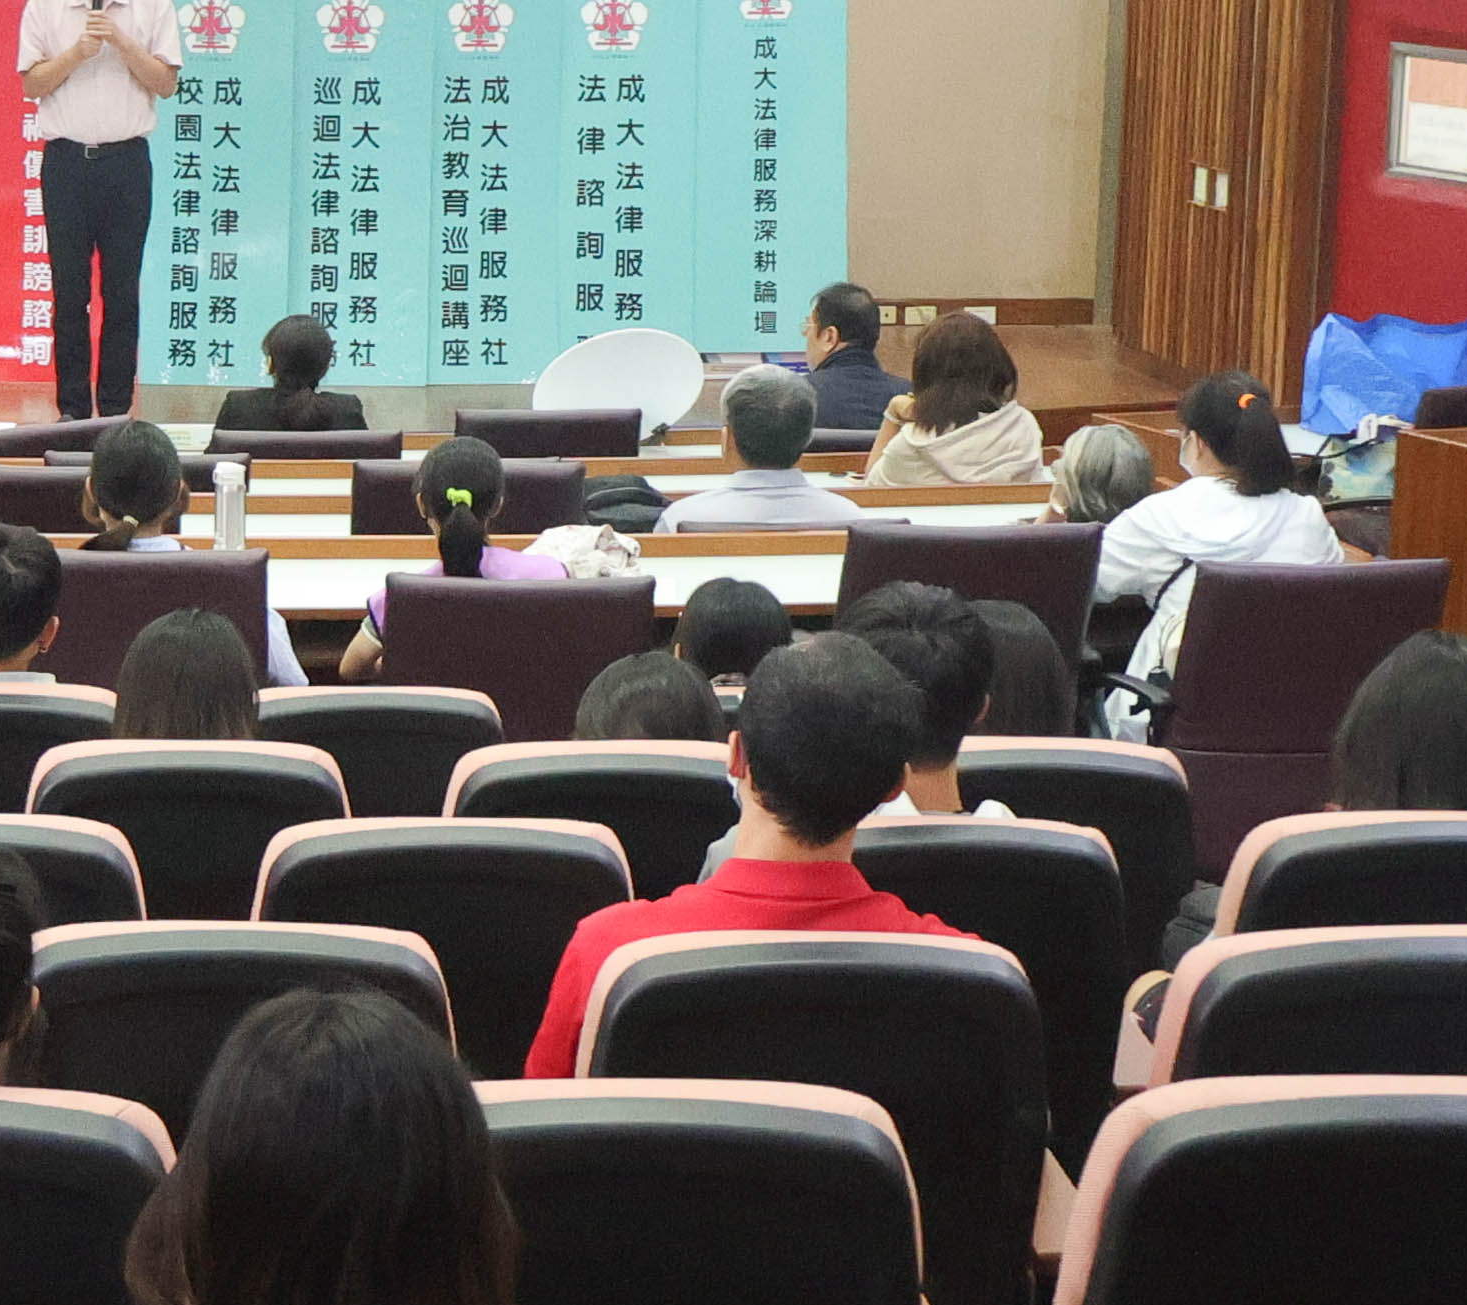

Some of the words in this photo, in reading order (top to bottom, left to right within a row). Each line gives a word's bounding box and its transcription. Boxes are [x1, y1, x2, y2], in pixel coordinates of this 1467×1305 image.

[168, 76, 204, 369] 校園法律諮詢服務
[207, 76, 243, 369] 成大法律服務社
[310, 76, 343, 368] 巡迴法律諮詢服
[348, 77, 382, 368] 成大法律服務社
[441, 75, 472, 368] 法治教育巡迴講座
[479, 75, 510, 367] 成大法律服務社
[575, 74, 607, 344] 法律諮詢服
[753, 36, 778, 334] 成大法律服務深耕論壇
